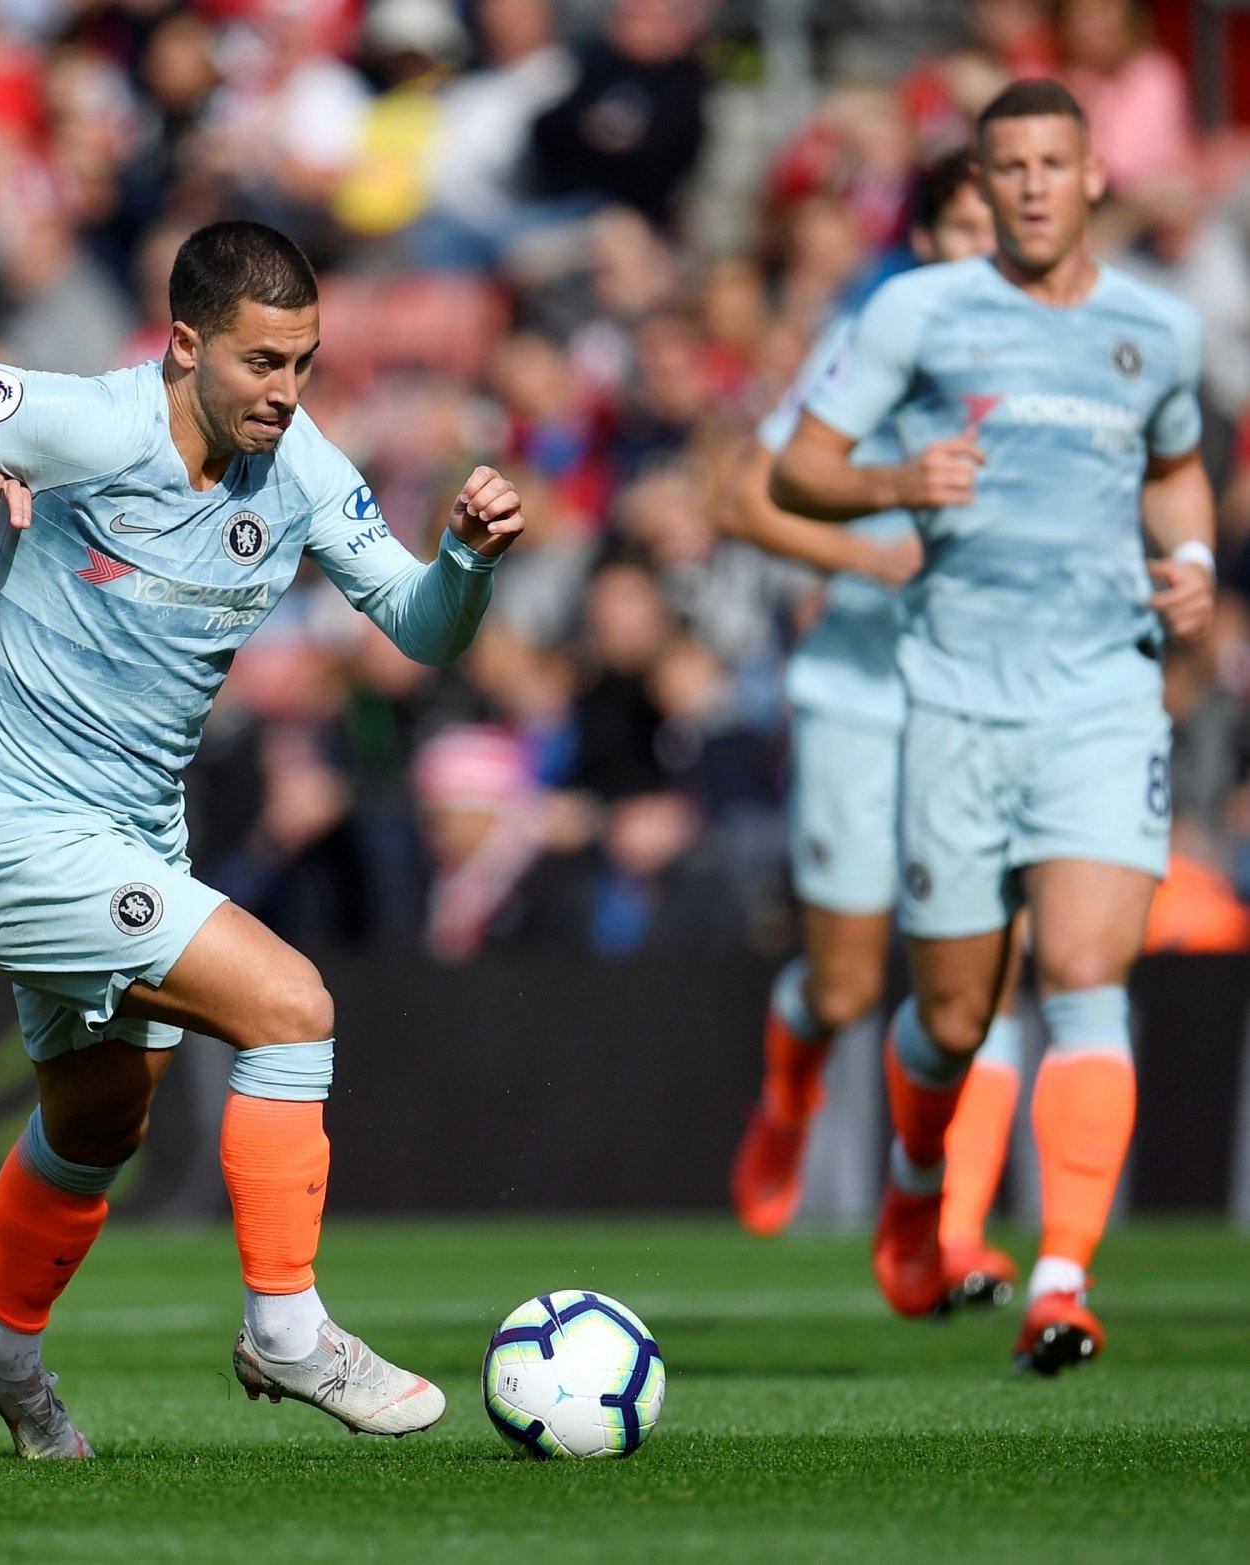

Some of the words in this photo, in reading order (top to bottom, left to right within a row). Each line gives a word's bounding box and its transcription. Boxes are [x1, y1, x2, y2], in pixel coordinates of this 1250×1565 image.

[230, 513, 261, 526] CHELSEA
[347, 524, 389, 555] HYU
[204, 609, 262, 631] TYRES
[1147, 753, 1171, 818] 8
